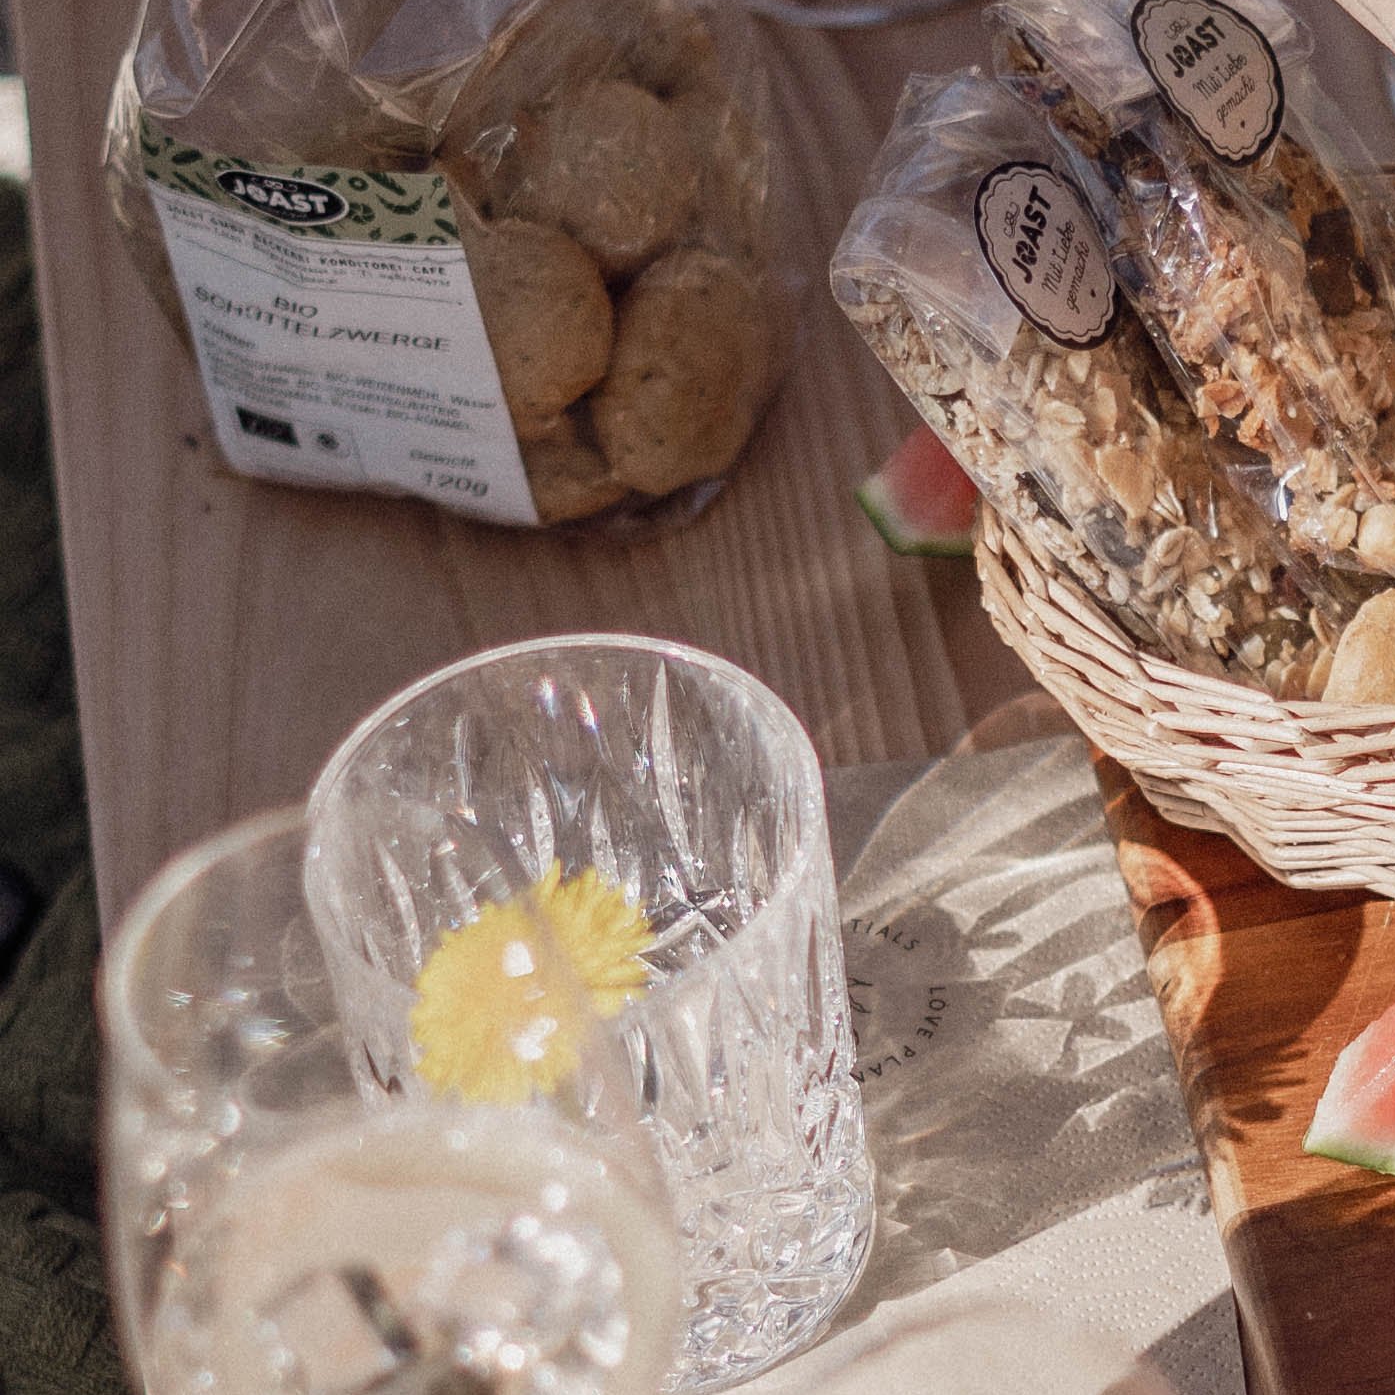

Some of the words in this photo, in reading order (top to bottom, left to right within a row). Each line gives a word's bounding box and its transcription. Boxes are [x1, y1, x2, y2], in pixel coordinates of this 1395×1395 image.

[1164, 15, 1227, 79] JOAST
[1193, 75, 1224, 100] Mit
[1215, 54, 1248, 86] Liebe
[1216, 76, 1256, 129] gemacht
[232, 177, 329, 215] JOAST
[1012, 185, 1052, 285] JOAST
[1051, 219, 1076, 266] Liebe
[1041, 263, 1064, 295] Mit
[1066, 240, 1091, 315] gemacht
[274, 295, 318, 319] BIO
[423, 469, 490, 498] 120g
[850, 918, 920, 951] TIALS
[916, 986, 947, 1039] LOVE
